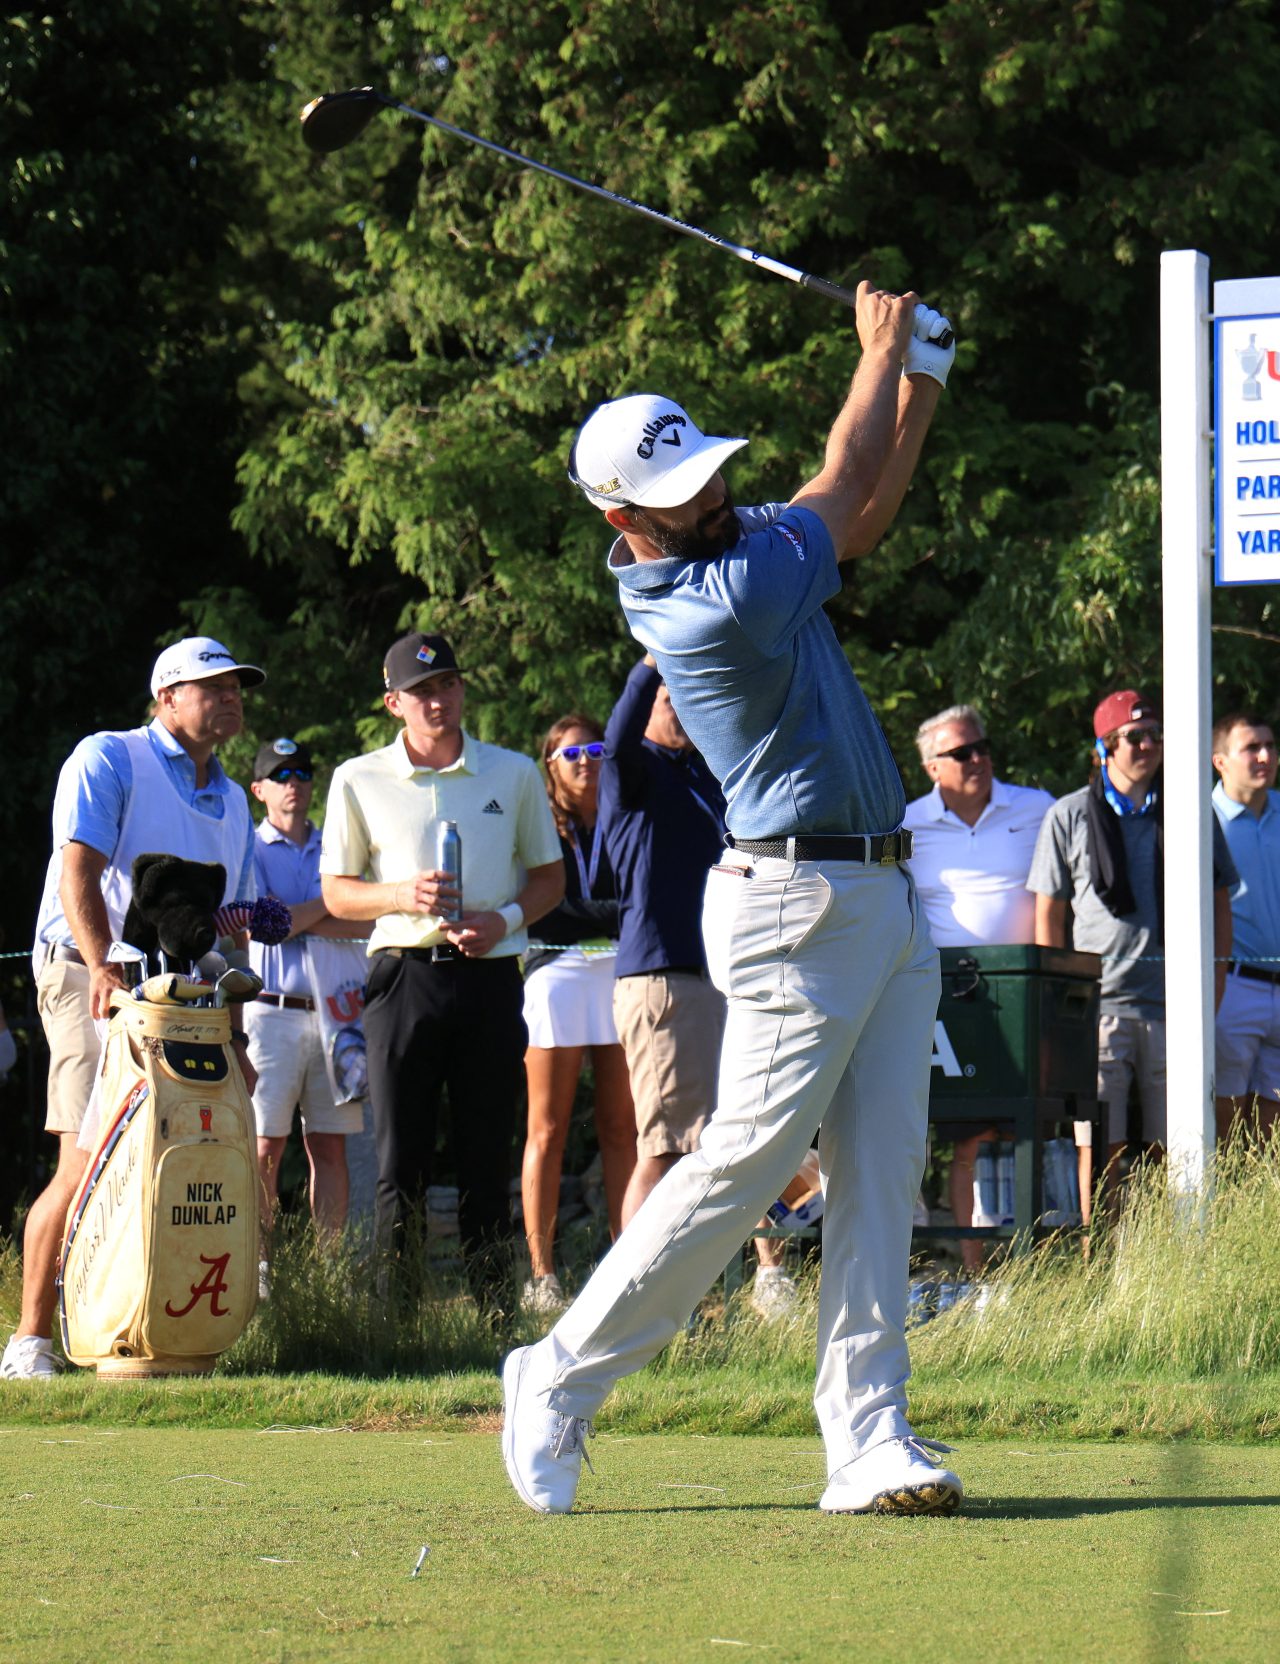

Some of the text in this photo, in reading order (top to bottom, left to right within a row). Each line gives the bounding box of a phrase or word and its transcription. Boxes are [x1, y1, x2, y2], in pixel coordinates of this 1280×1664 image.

[637, 414, 687, 459] Callaway
[187, 1183, 223, 1202] NICK
[172, 1205, 236, 1225] DUNLAP
